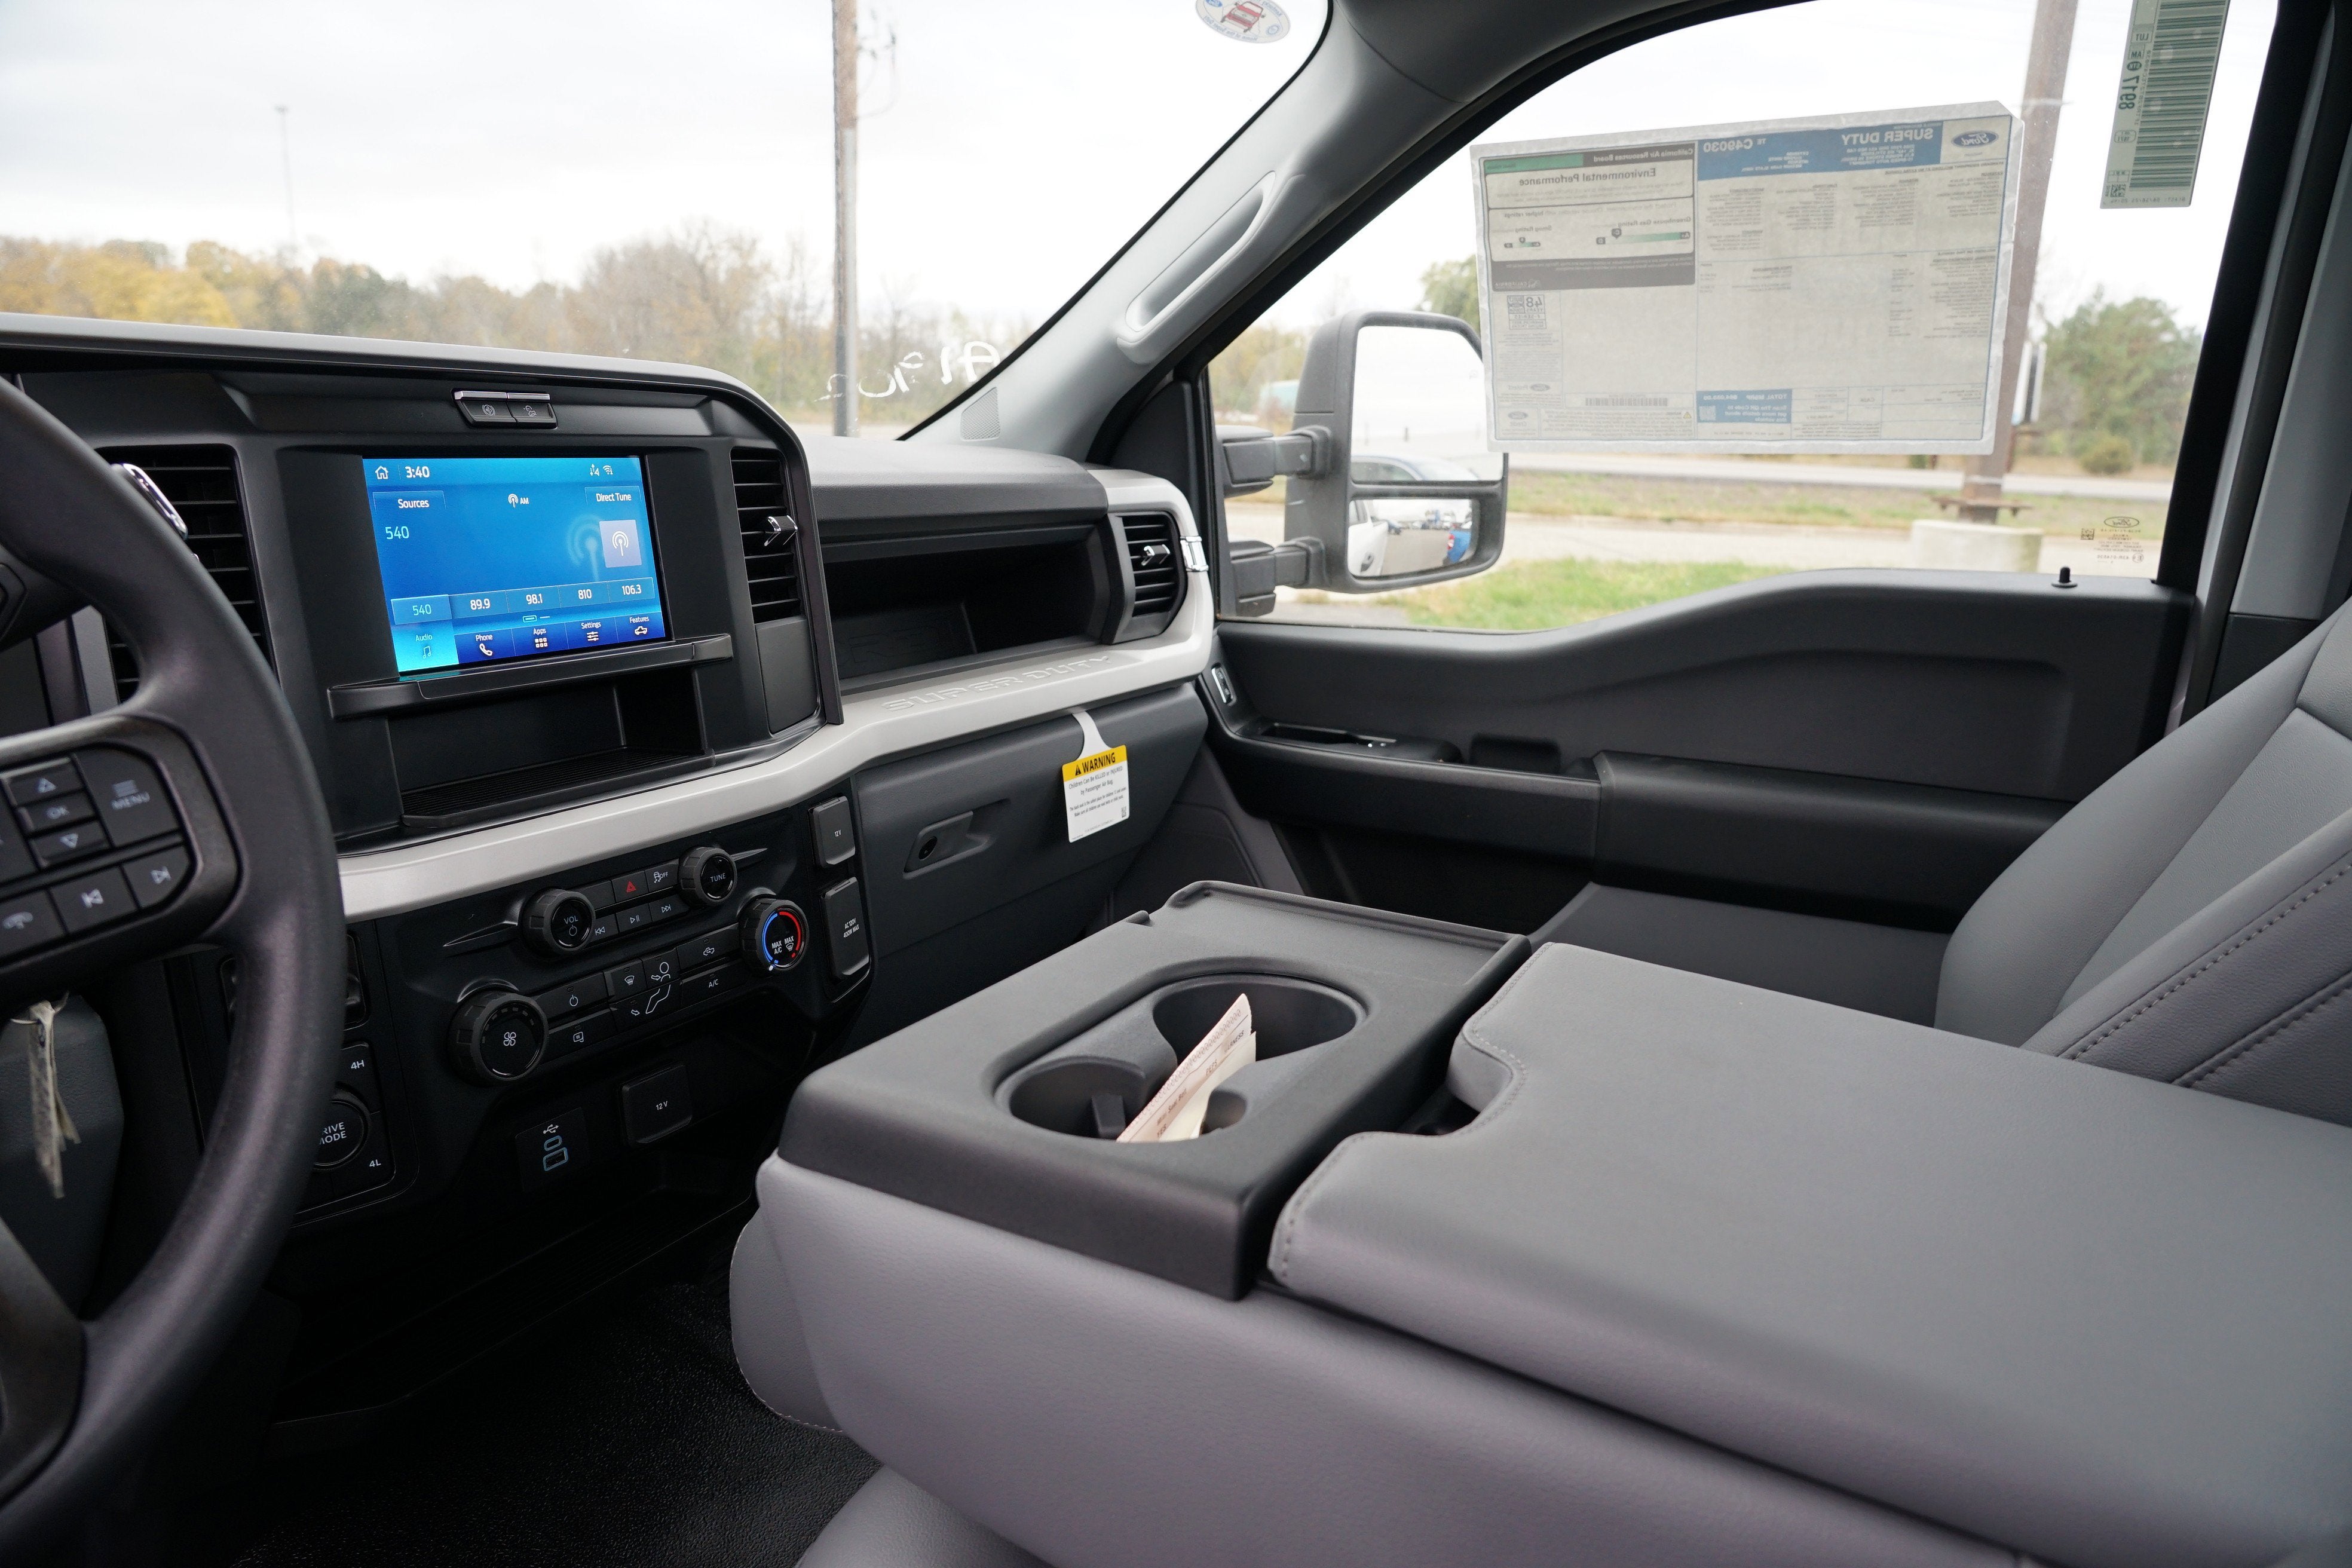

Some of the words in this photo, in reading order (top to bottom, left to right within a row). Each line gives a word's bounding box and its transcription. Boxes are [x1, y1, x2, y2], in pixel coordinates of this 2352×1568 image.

[406, 466, 430, 479] 3:40
[596, 492, 614, 503] Direct
[616, 492, 632, 502] Tune
[397, 498, 430, 509] Sources
[385, 526, 409, 540] 540
[578, 589, 592, 600] 810
[621, 584, 642, 596] 106.3
[470, 598, 490, 610] 89.9
[526, 593, 543, 605] 98.1
[412, 603, 432, 616] 540
[581, 620, 601, 629] Settings
[629, 615, 650, 623] Features
[533, 627, 546, 636] Apps
[476, 633, 493, 642] Phone
[882, 676, 1024, 712] SUPER
[1021, 656, 1112, 681] DUTY
[1082, 752, 1116, 773] WARNING
[1068, 780, 1083, 789] Children
[1110, 765, 1123, 775] INJURED
[1085, 784, 1101, 793] Passenger
[710, 872, 726, 883] TUNE
[564, 915, 579, 924] VOL
[771, 940, 782, 949] MAX
[784, 935, 794, 944] MAX
[709, 979, 719, 988] A/C
[350, 1059, 365, 1070] 4H
[322, 1122, 345, 1135] RIVE
[369, 1159, 381, 1168] 4L
